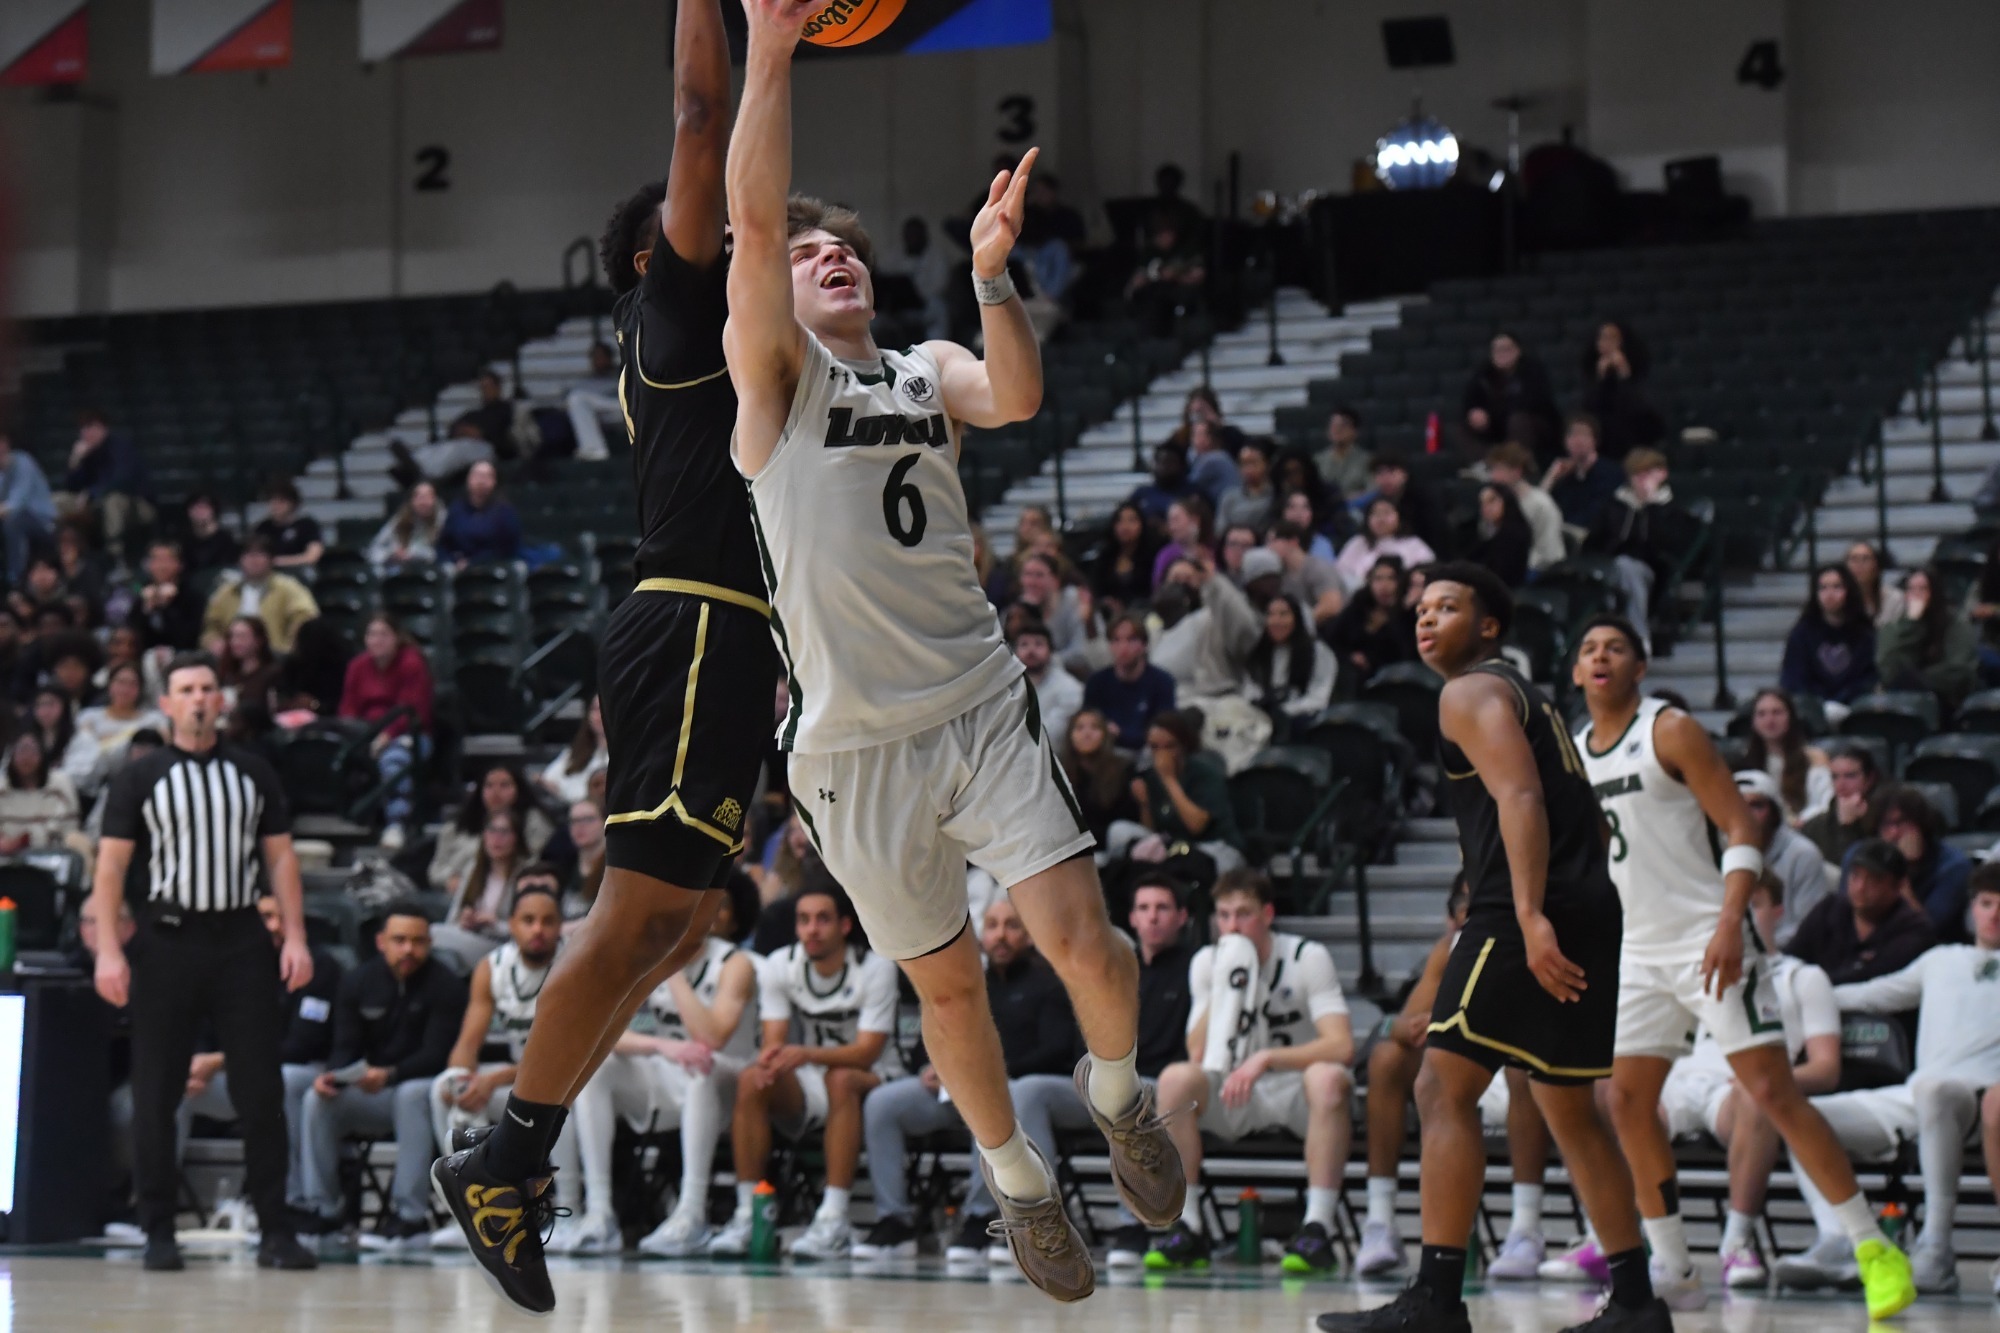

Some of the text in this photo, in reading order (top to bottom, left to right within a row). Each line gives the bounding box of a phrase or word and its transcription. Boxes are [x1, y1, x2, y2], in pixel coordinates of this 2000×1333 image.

[1737, 41, 1785, 91] 4
[998, 94, 1036, 143] 3
[415, 145, 450, 192] 2
[882, 452, 927, 547] 6
